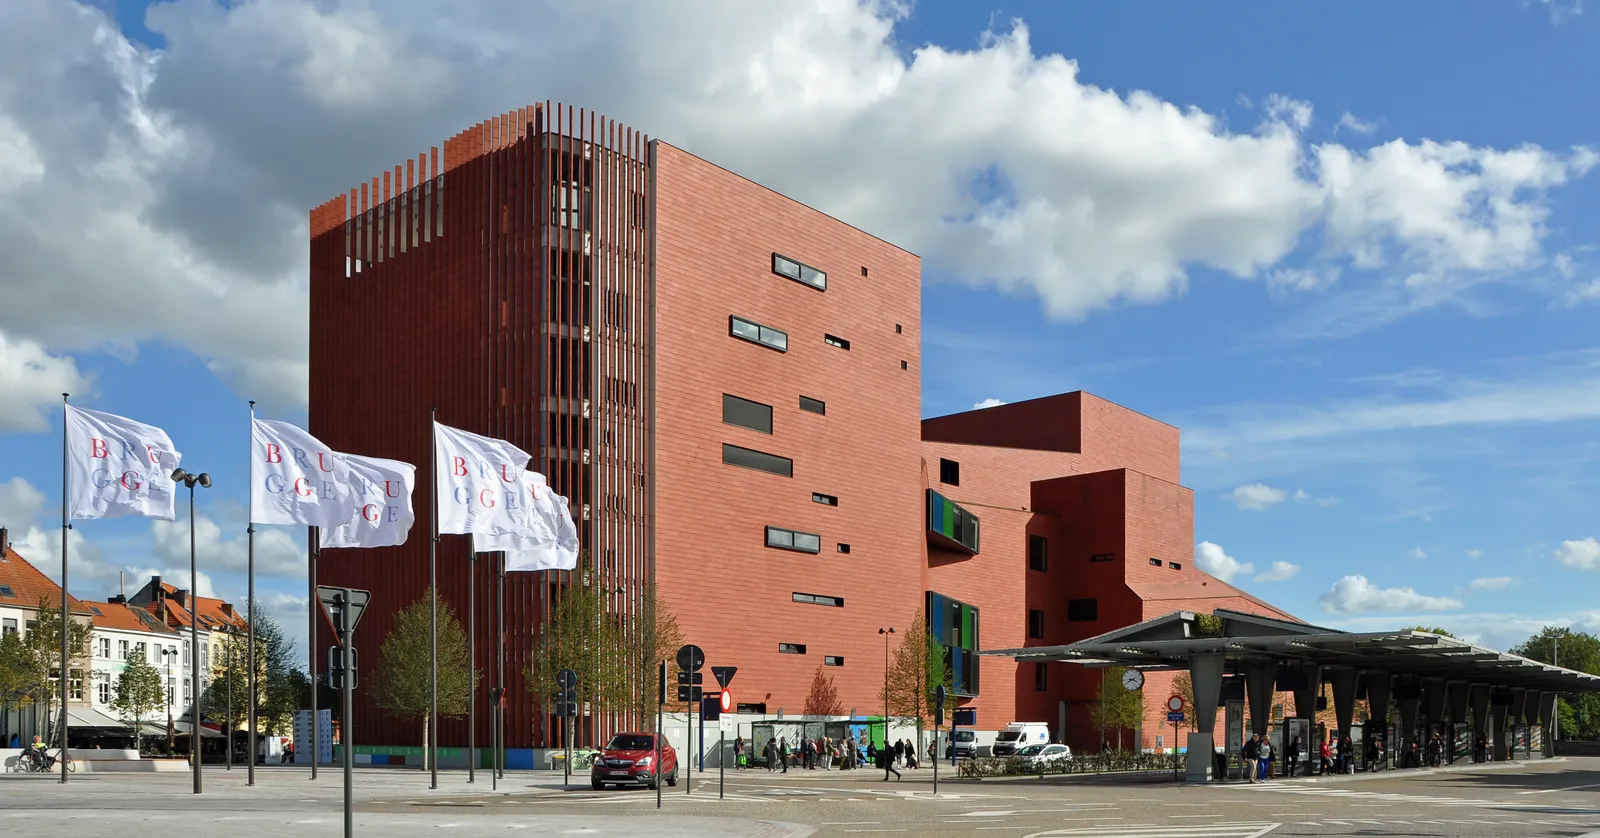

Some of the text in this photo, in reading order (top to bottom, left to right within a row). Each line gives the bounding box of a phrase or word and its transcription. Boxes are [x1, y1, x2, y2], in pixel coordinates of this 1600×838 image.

[265, 443, 335, 473] BRU
[453, 456, 517, 483] BRU
[265, 473, 336, 501] GGE
[361, 478, 401, 498] RU
[453, 486, 519, 510] GGE
[361, 503, 399, 523] GE
